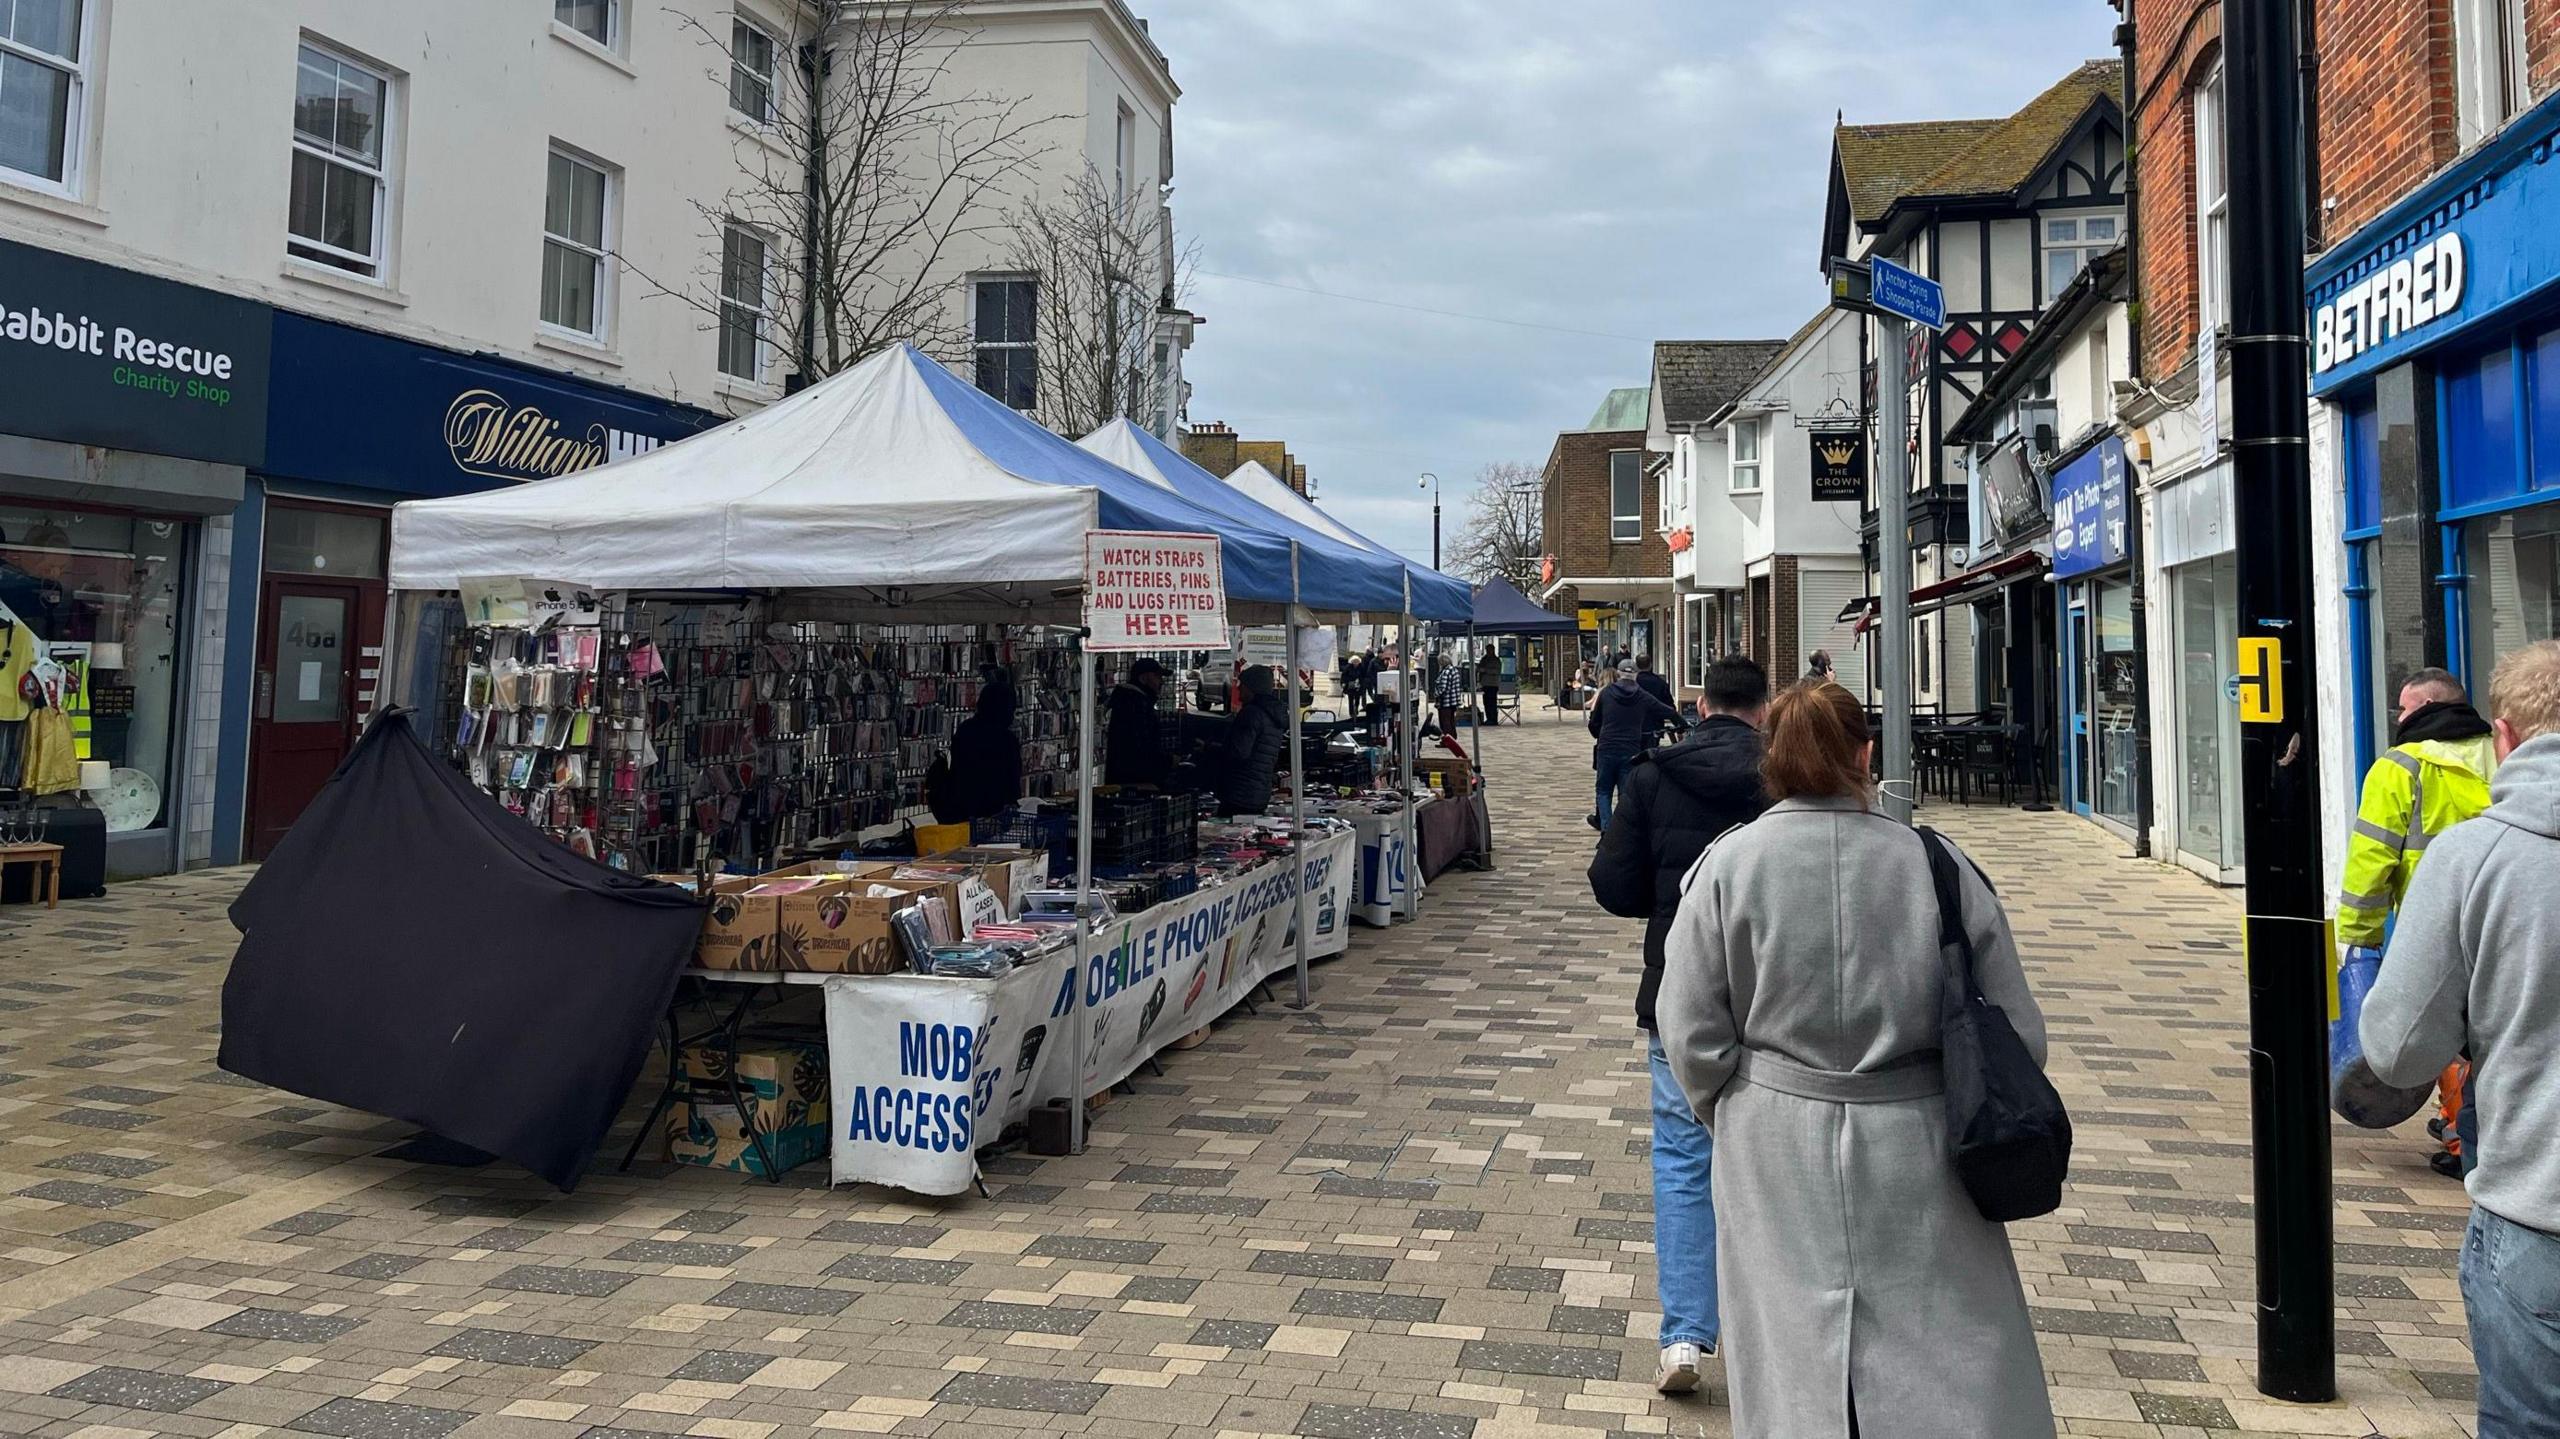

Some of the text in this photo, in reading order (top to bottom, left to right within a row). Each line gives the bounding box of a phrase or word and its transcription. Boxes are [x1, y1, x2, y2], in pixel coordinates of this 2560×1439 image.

[1886, 269, 1928, 302] Anchor Spring
[1886, 287, 1937, 320] Shopping Parade
[2316, 232, 2463, 374] BETFRED
[0, 303, 232, 379] abbit Rescue
[112, 367, 231, 407] Charity Shop
[444, 389, 609, 479] William
[1815, 477, 1860, 487] CROWN
[1828, 468, 1848, 476] THE
[2055, 495, 2073, 532] MAX
[2074, 488, 2084, 514] The
[2084, 480, 2100, 510] Photo
[2079, 517, 2097, 552] Expert
[1103, 549, 1205, 567] WATCH STRAPS
[1097, 571, 1210, 591] BATTERIES, PINS
[535, 601, 575, 609] iPhone 5
[1095, 593, 1214, 610] AND LUGS FITTED
[1125, 614, 1190, 635] HERE
[966, 886, 978, 900] ALL
[975, 895, 993, 914] CASES
[1162, 895, 1233, 968] PHONE
